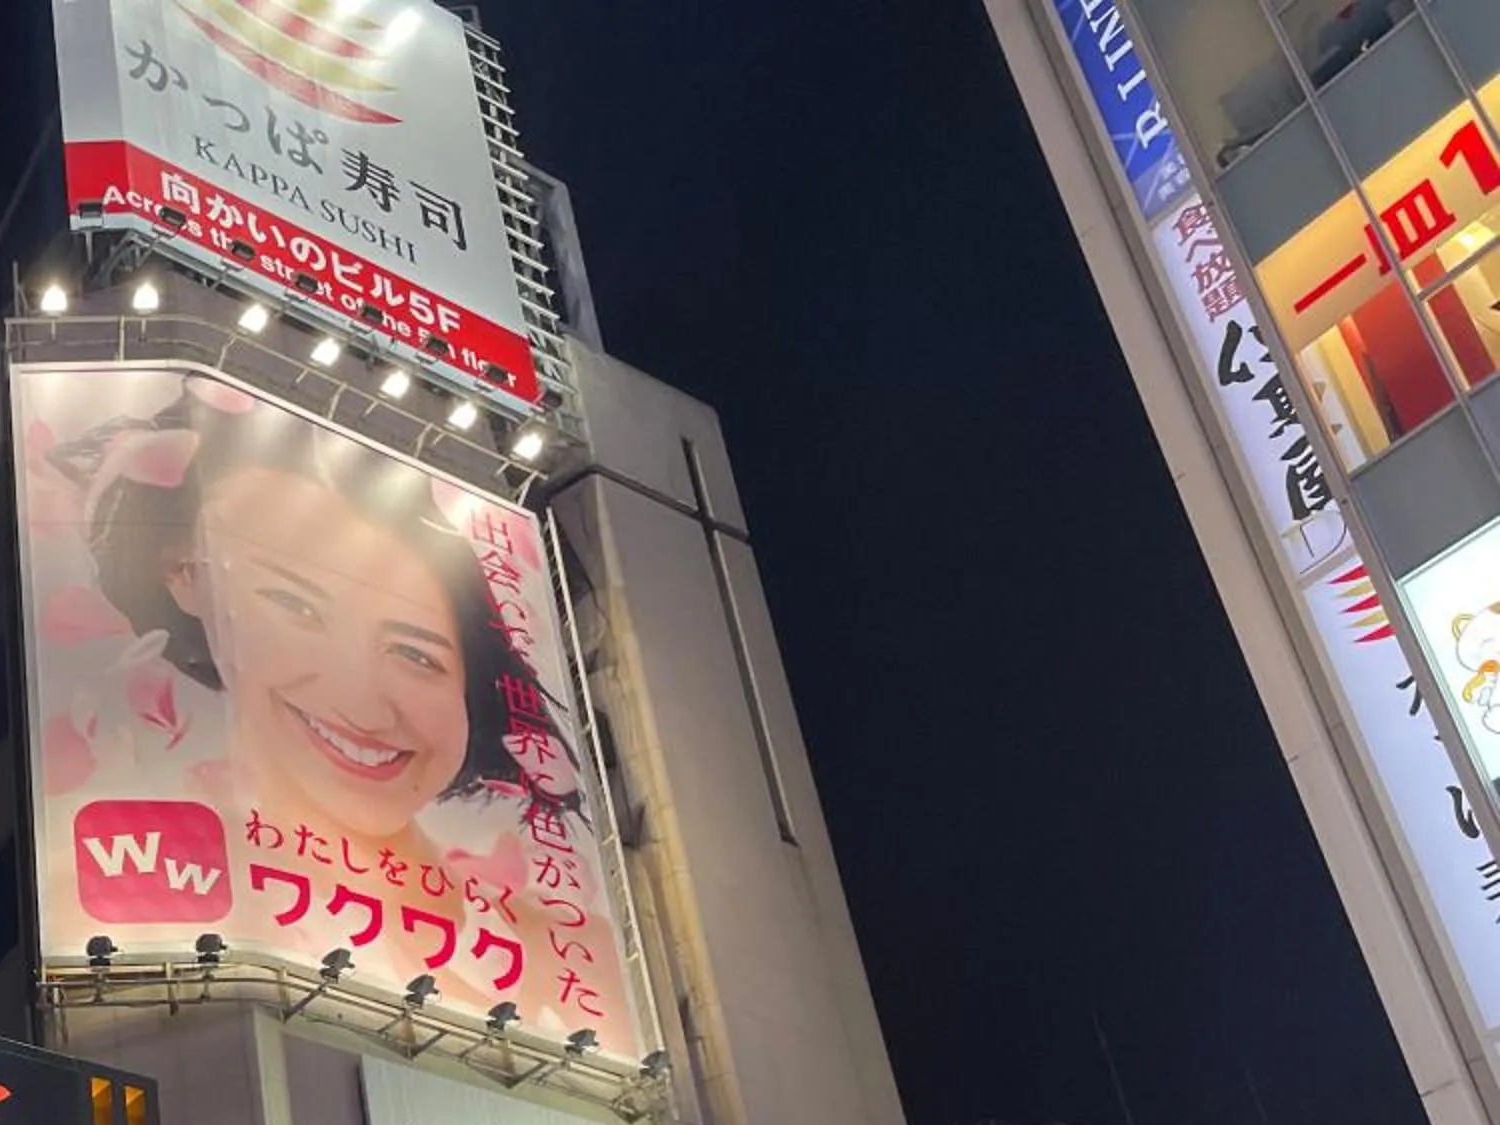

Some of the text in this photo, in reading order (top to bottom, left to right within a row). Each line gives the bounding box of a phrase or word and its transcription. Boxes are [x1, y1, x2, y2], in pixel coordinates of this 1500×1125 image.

[125, 39, 468, 252] かっぱ寿司
[194, 135, 418, 266] KAPPA SUSHI
[102, 185, 203, 237] Acrs
[160, 170, 463, 335] 向かいのビル5F
[243, 809, 518, 926] わたしをひらく
[249, 863, 525, 992] ワクワク
